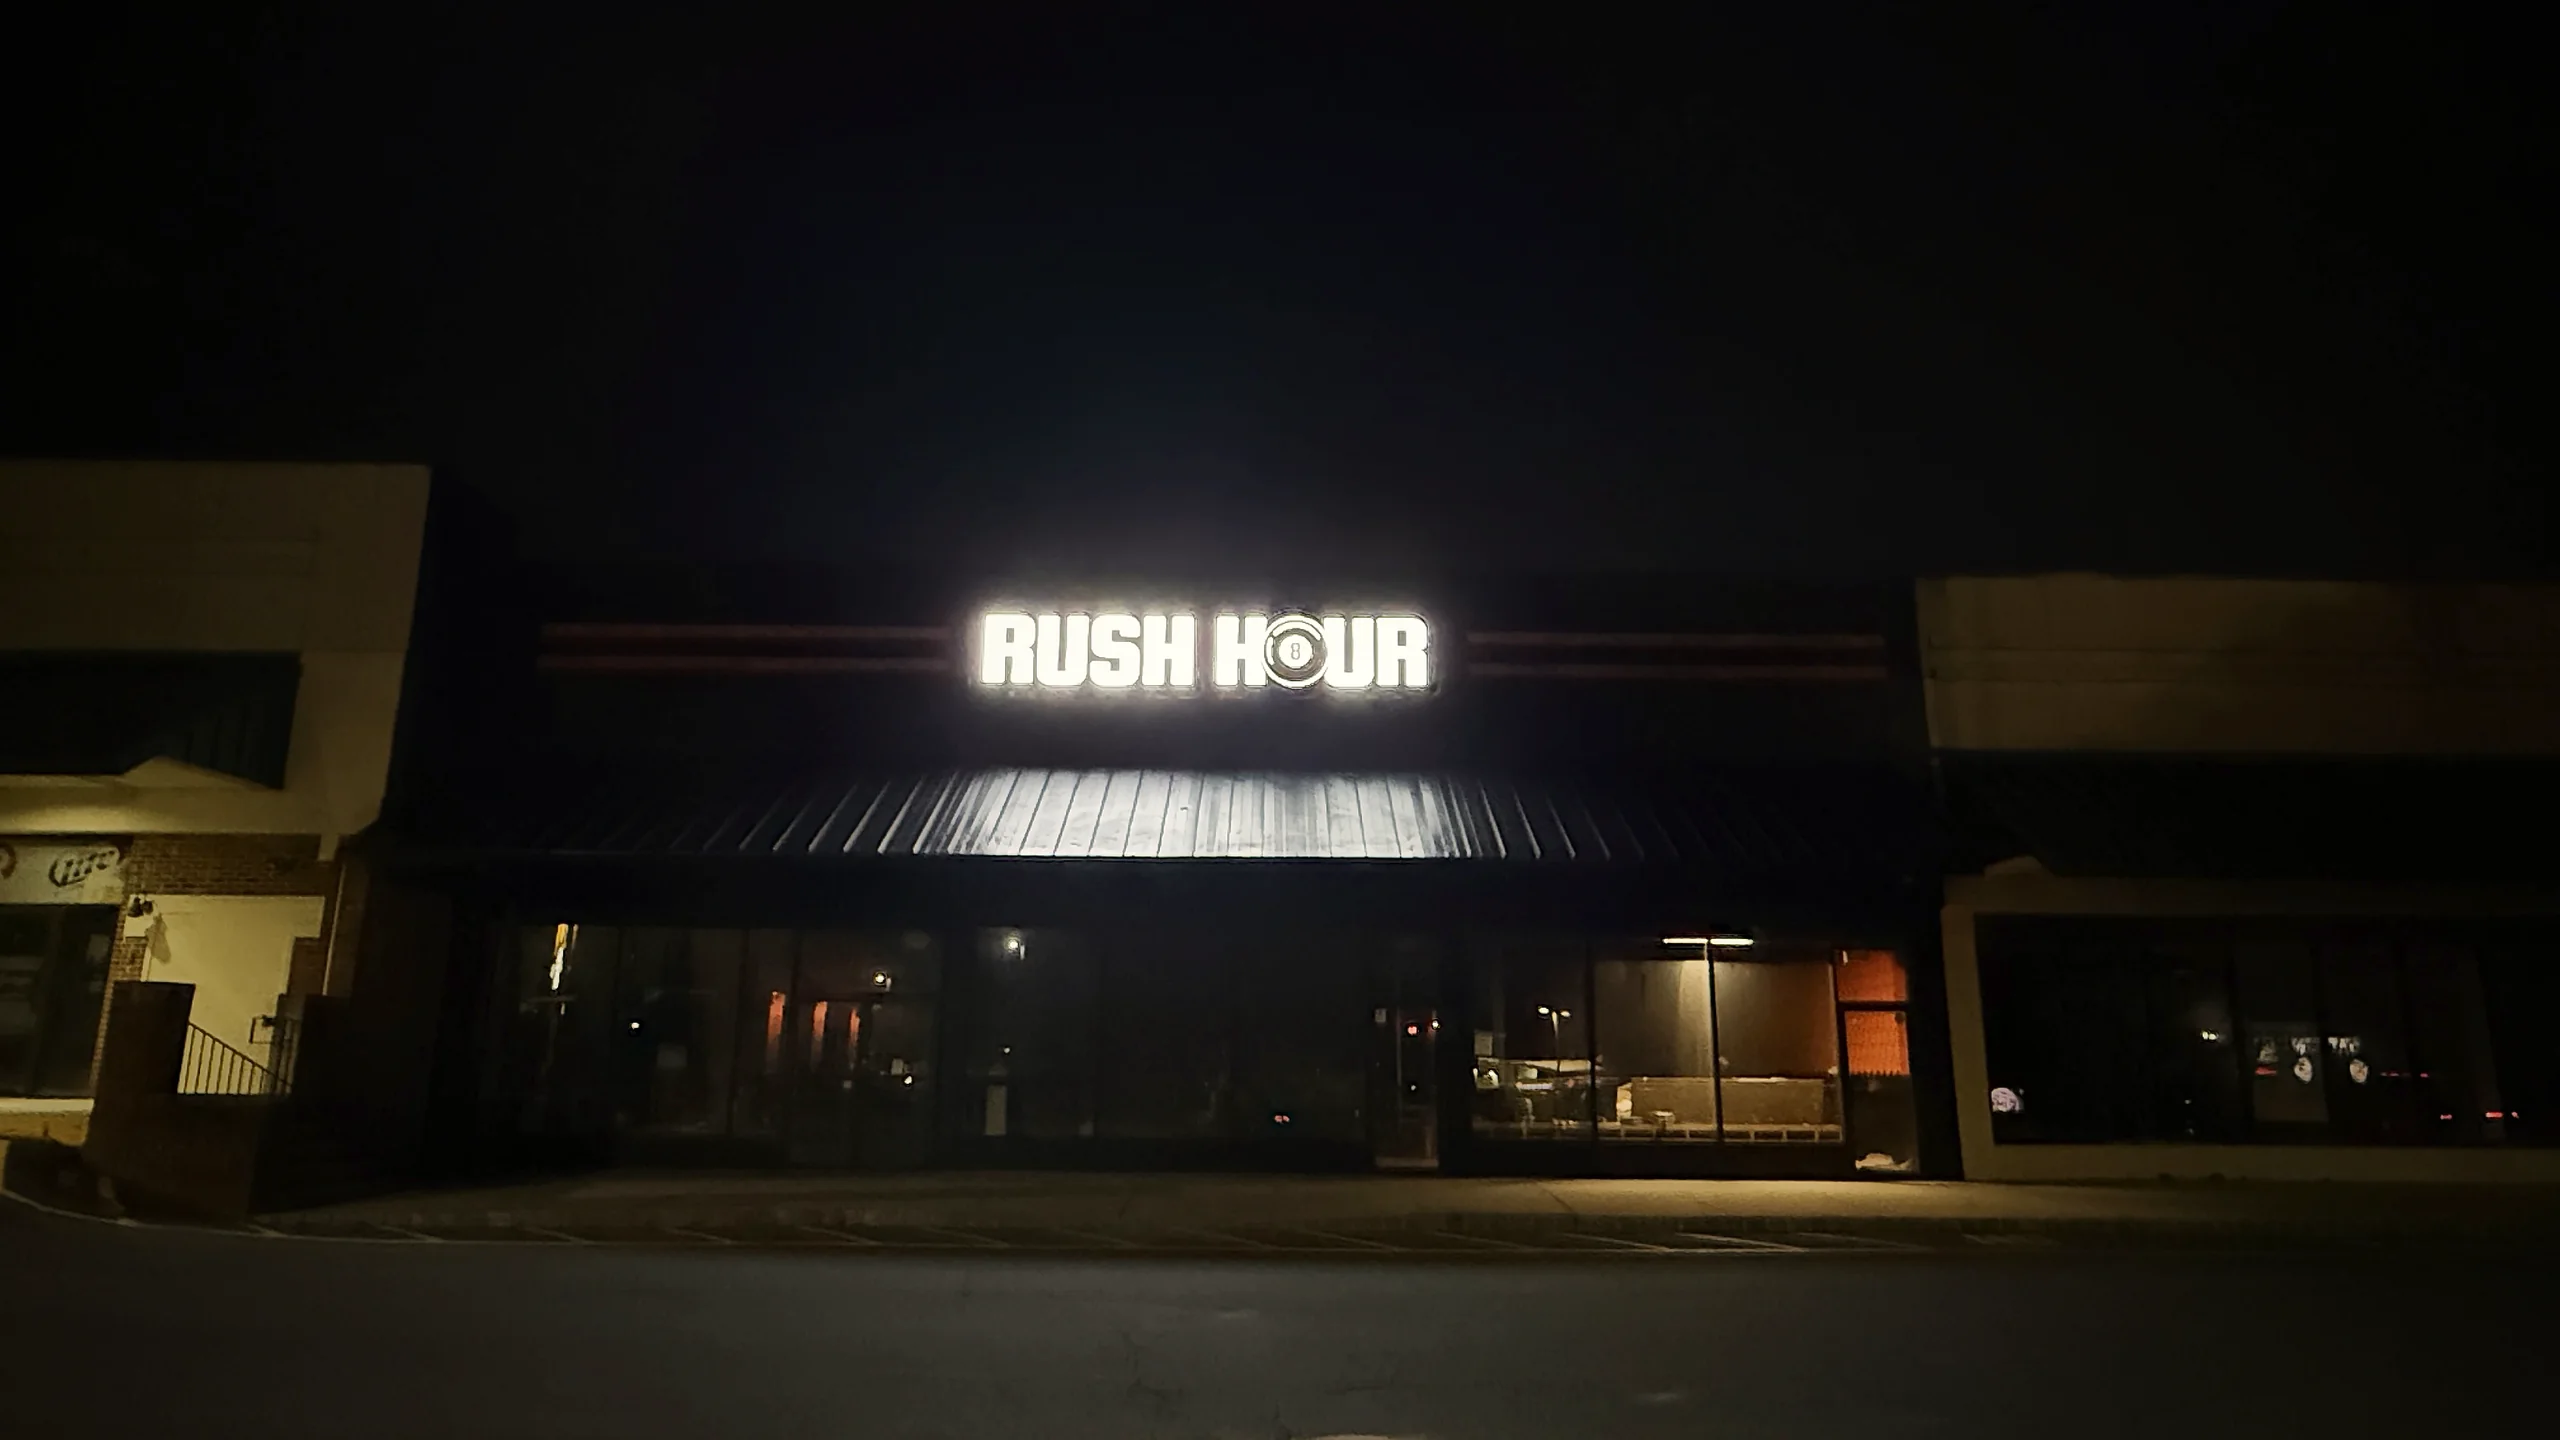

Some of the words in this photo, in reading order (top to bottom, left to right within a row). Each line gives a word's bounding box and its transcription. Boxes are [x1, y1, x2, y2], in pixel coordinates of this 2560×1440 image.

[981, 613, 1198, 687] RUSH
[1213, 611, 1431, 690] HOUR
[1290, 642, 1301, 661] 8
